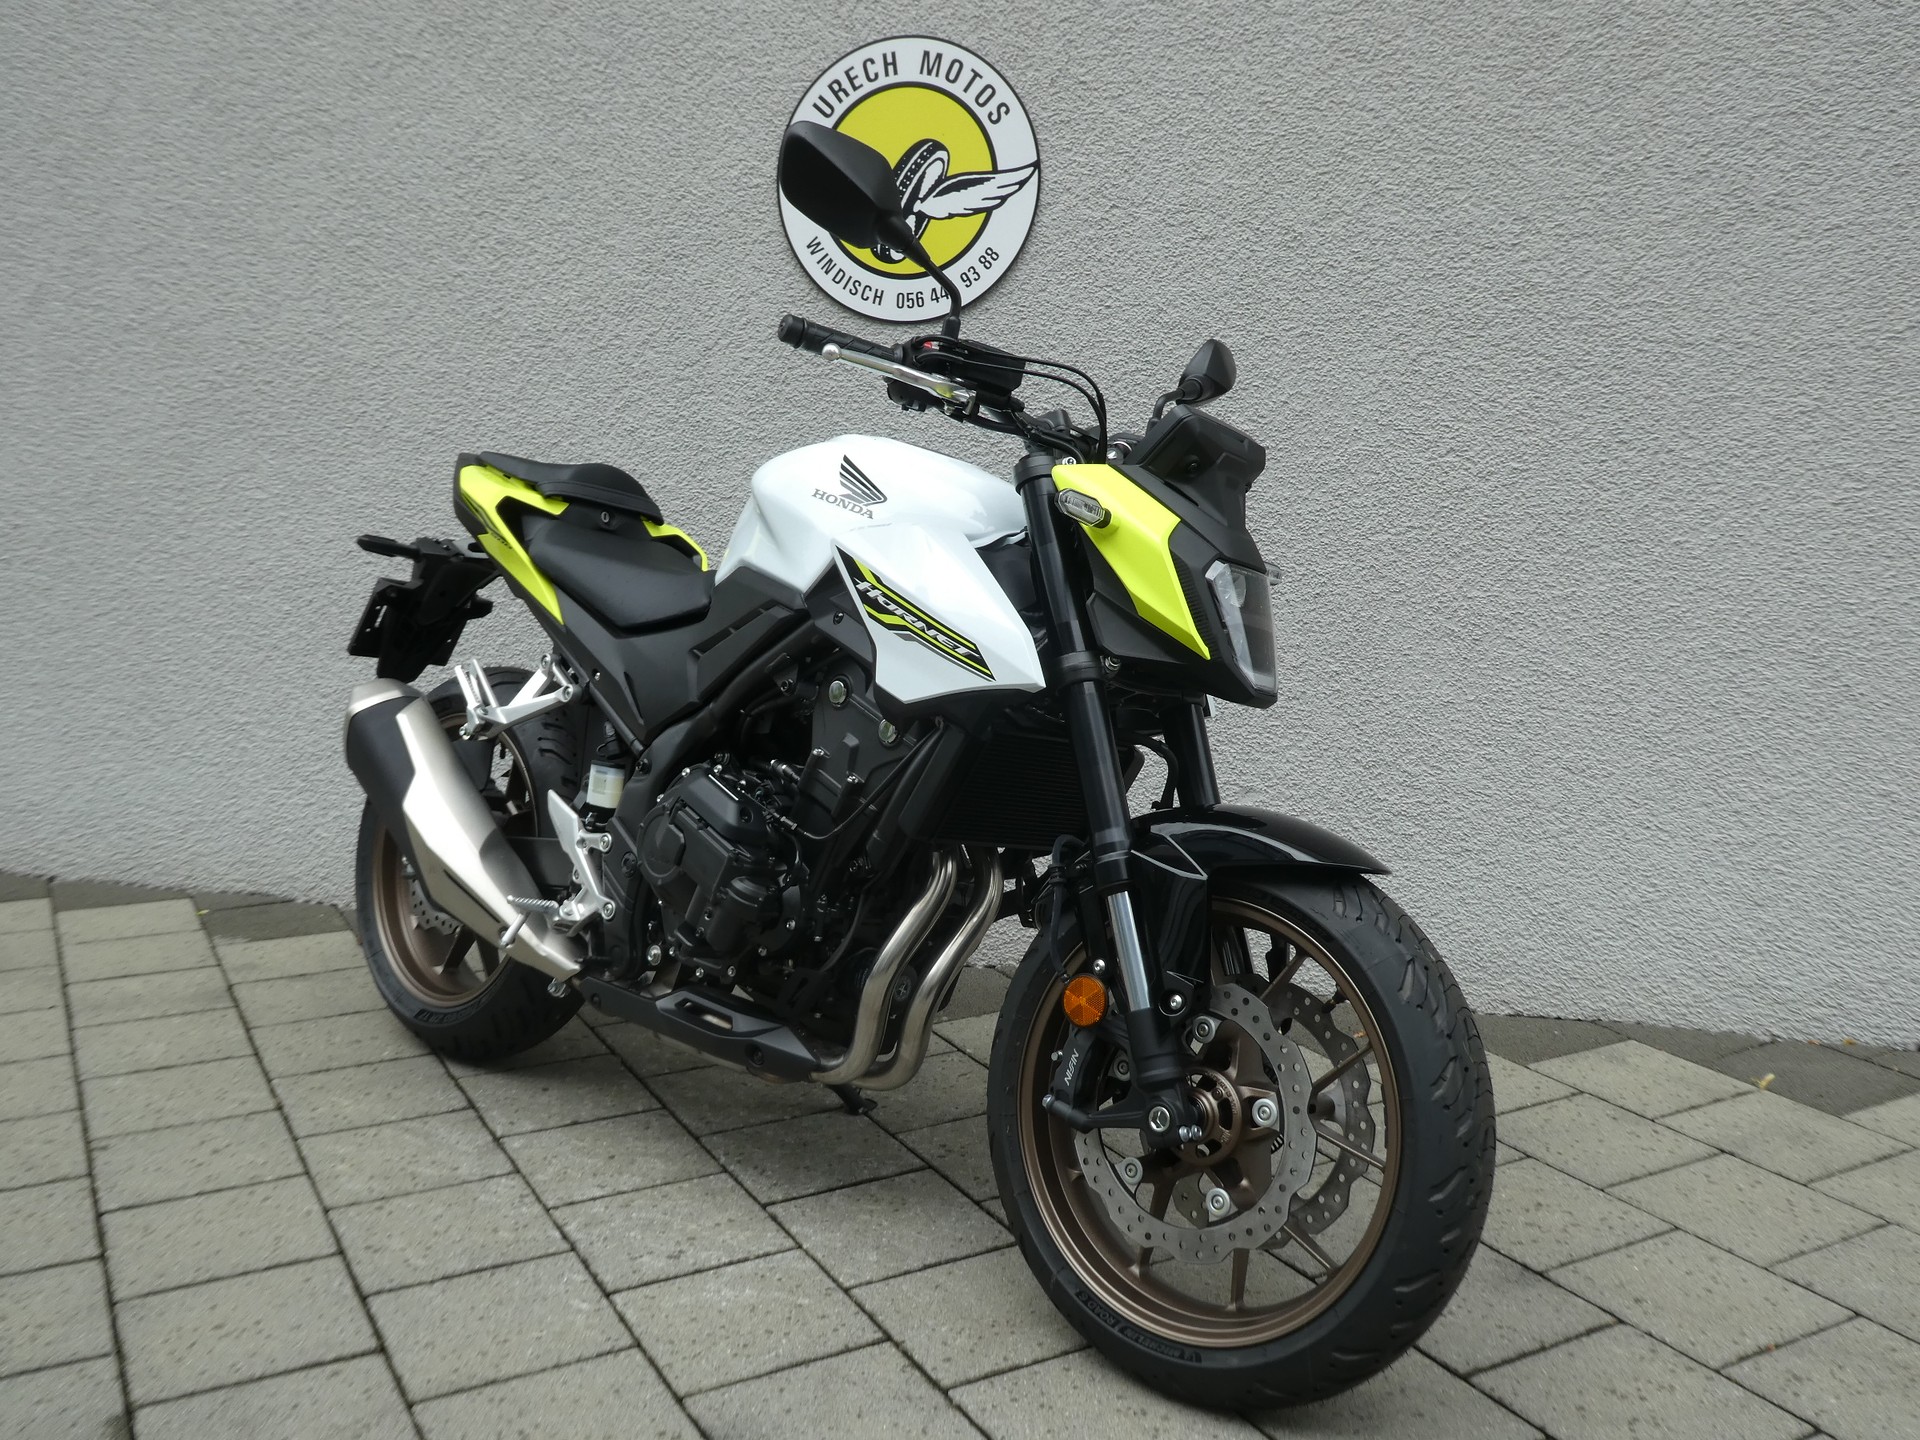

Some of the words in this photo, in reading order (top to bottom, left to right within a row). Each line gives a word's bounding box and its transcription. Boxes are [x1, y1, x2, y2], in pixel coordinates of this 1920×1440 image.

[812, 51, 898, 119] URECH
[920, 50, 1011, 125] MOTOS
[806, 236, 885, 306] WINDISCH
[896, 290, 925, 309] 056
[960, 265, 982, 289] 93
[979, 246, 1000, 270] 88
[811, 488, 874, 520] HONDA
[853, 577, 981, 659] HORNET
[1064, 1048, 1079, 1087] NISSIN
[1087, 1301, 1115, 1327] ROAD
